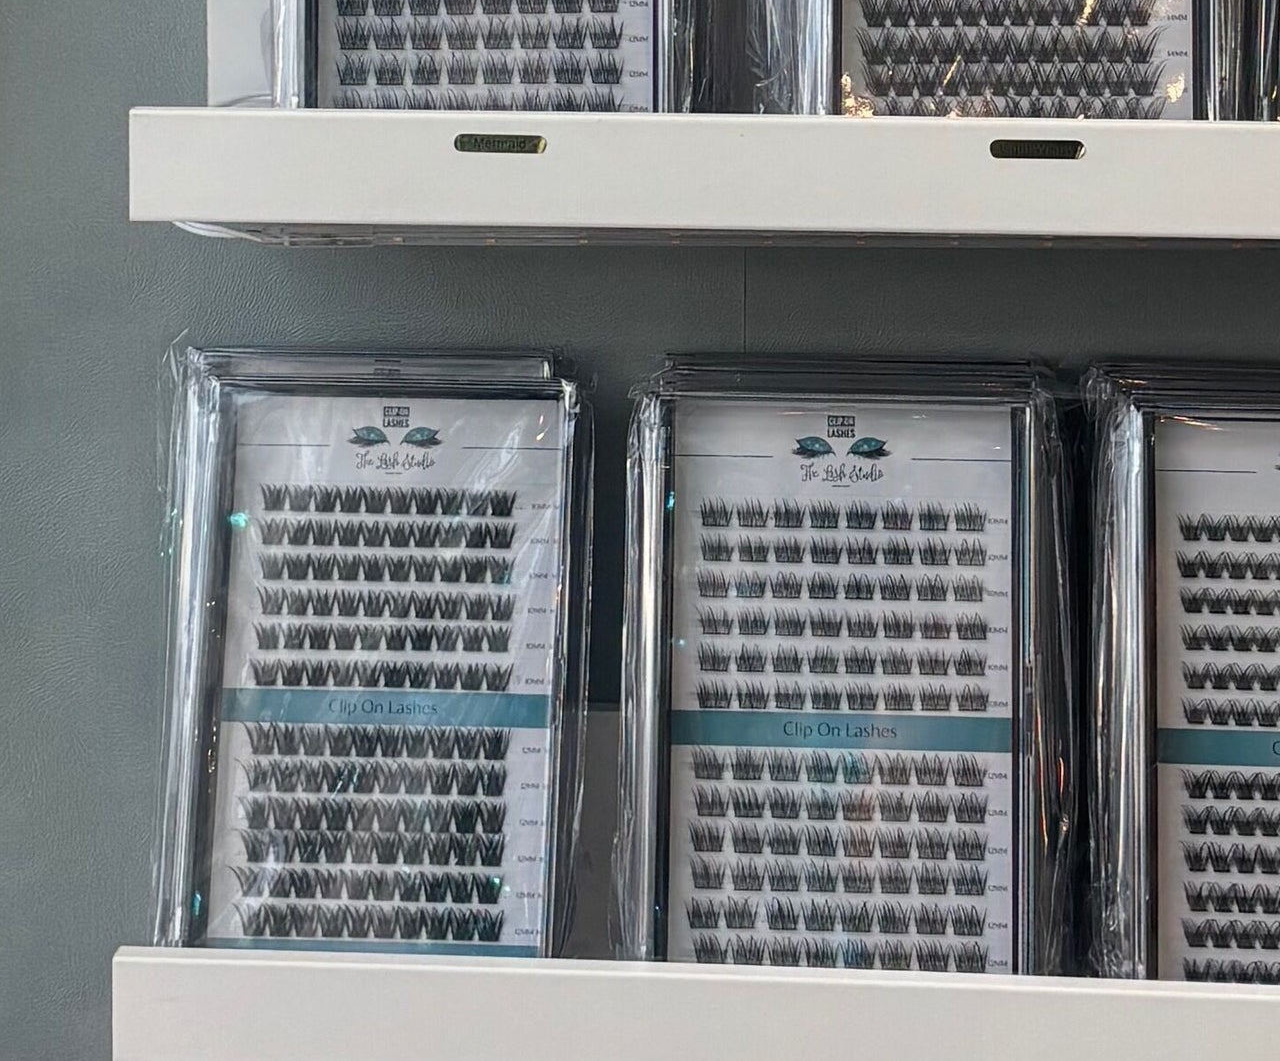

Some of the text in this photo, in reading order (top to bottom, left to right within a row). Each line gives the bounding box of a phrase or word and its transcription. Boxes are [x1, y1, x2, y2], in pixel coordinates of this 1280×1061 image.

[383, 418, 409, 428] LASHES
[827, 428, 855, 438] LASHES
[328, 698, 438, 716] Clip On Lashes
[783, 721, 897, 739] Clip On Lashes
